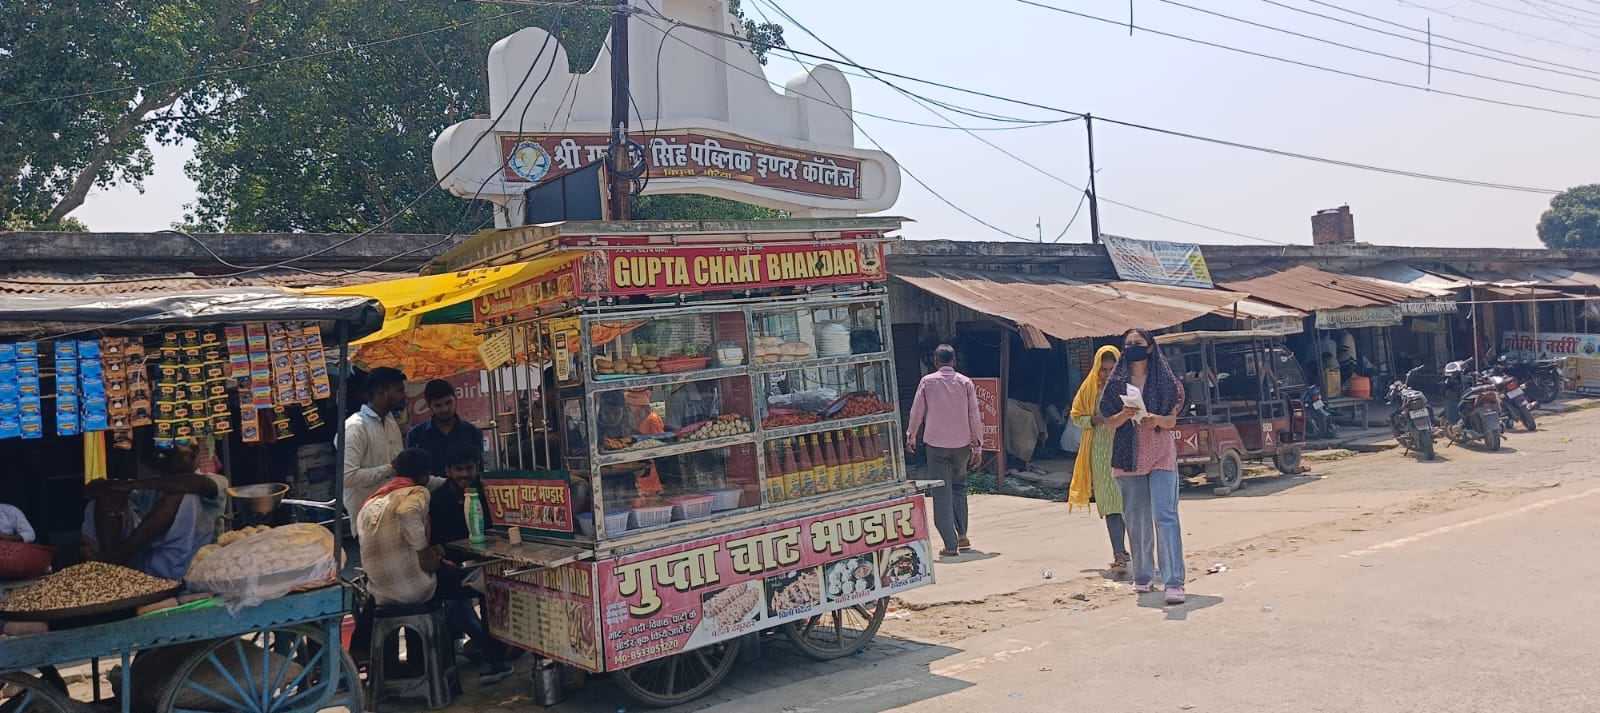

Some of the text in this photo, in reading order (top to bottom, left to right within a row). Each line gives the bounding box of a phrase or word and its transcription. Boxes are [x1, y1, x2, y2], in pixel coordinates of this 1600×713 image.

[553, 138, 582, 170] श्री
[649, 138, 688, 168] सिंह
[688, 138, 754, 172] पब्लिक
[755, 152, 801, 180] इण्टर
[801, 156, 856, 189] कॉलेज
[613, 255, 691, 288] GUPTA
[691, 252, 763, 286] CHAAT
[766, 248, 858, 281] BHANDAR
[1262, 422, 1273, 432] SRD
[484, 484, 520, 519] गुप्ता
[520, 485, 538, 502] चाट
[537, 485, 565, 504] भण्डार
[613, 543, 721, 619] गुप्ता
[726, 525, 802, 575] चाट
[809, 501, 916, 556] भण्डार
[543, 565, 590, 597] BHANDAR
